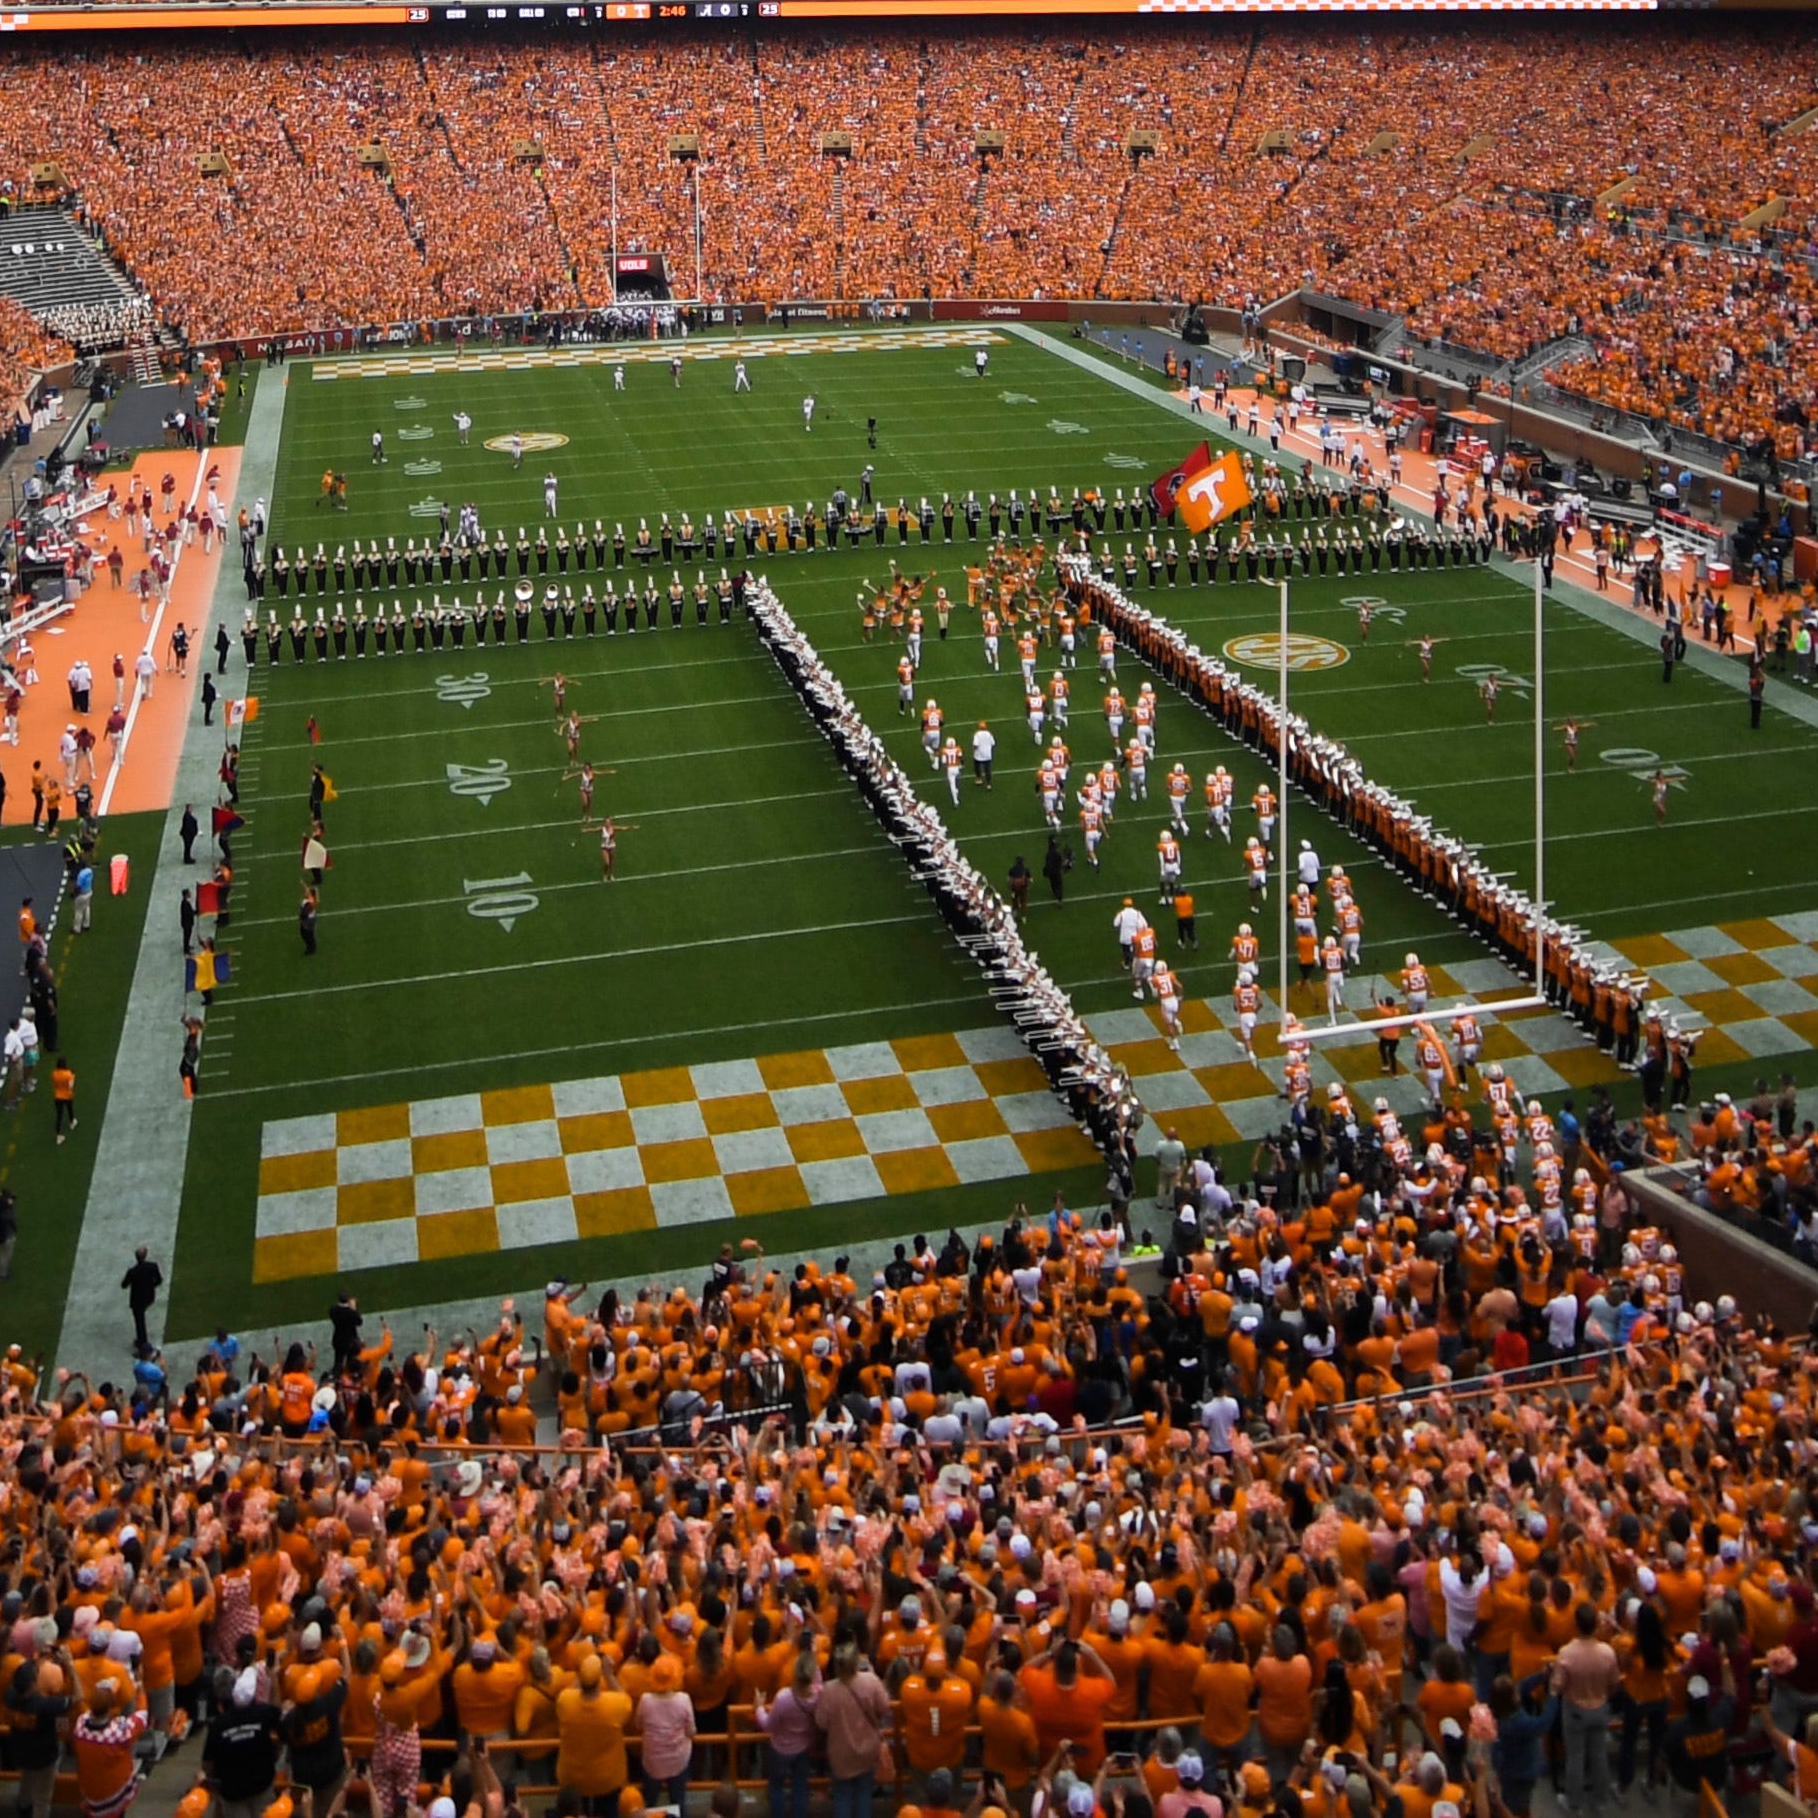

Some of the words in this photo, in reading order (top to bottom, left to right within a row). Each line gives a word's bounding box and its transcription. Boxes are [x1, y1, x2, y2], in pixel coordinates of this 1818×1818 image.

[659, 5, 686, 17] 2:46
[762, 3, 778, 15] 25
[618, 259, 648, 271] VOLS
[1188, 469, 1226, 520] T
[446, 758, 512, 797] 20
[463, 870, 540, 920] 10
[984, 1372, 996, 1393] 5
[929, 1707, 940, 1736] 1
